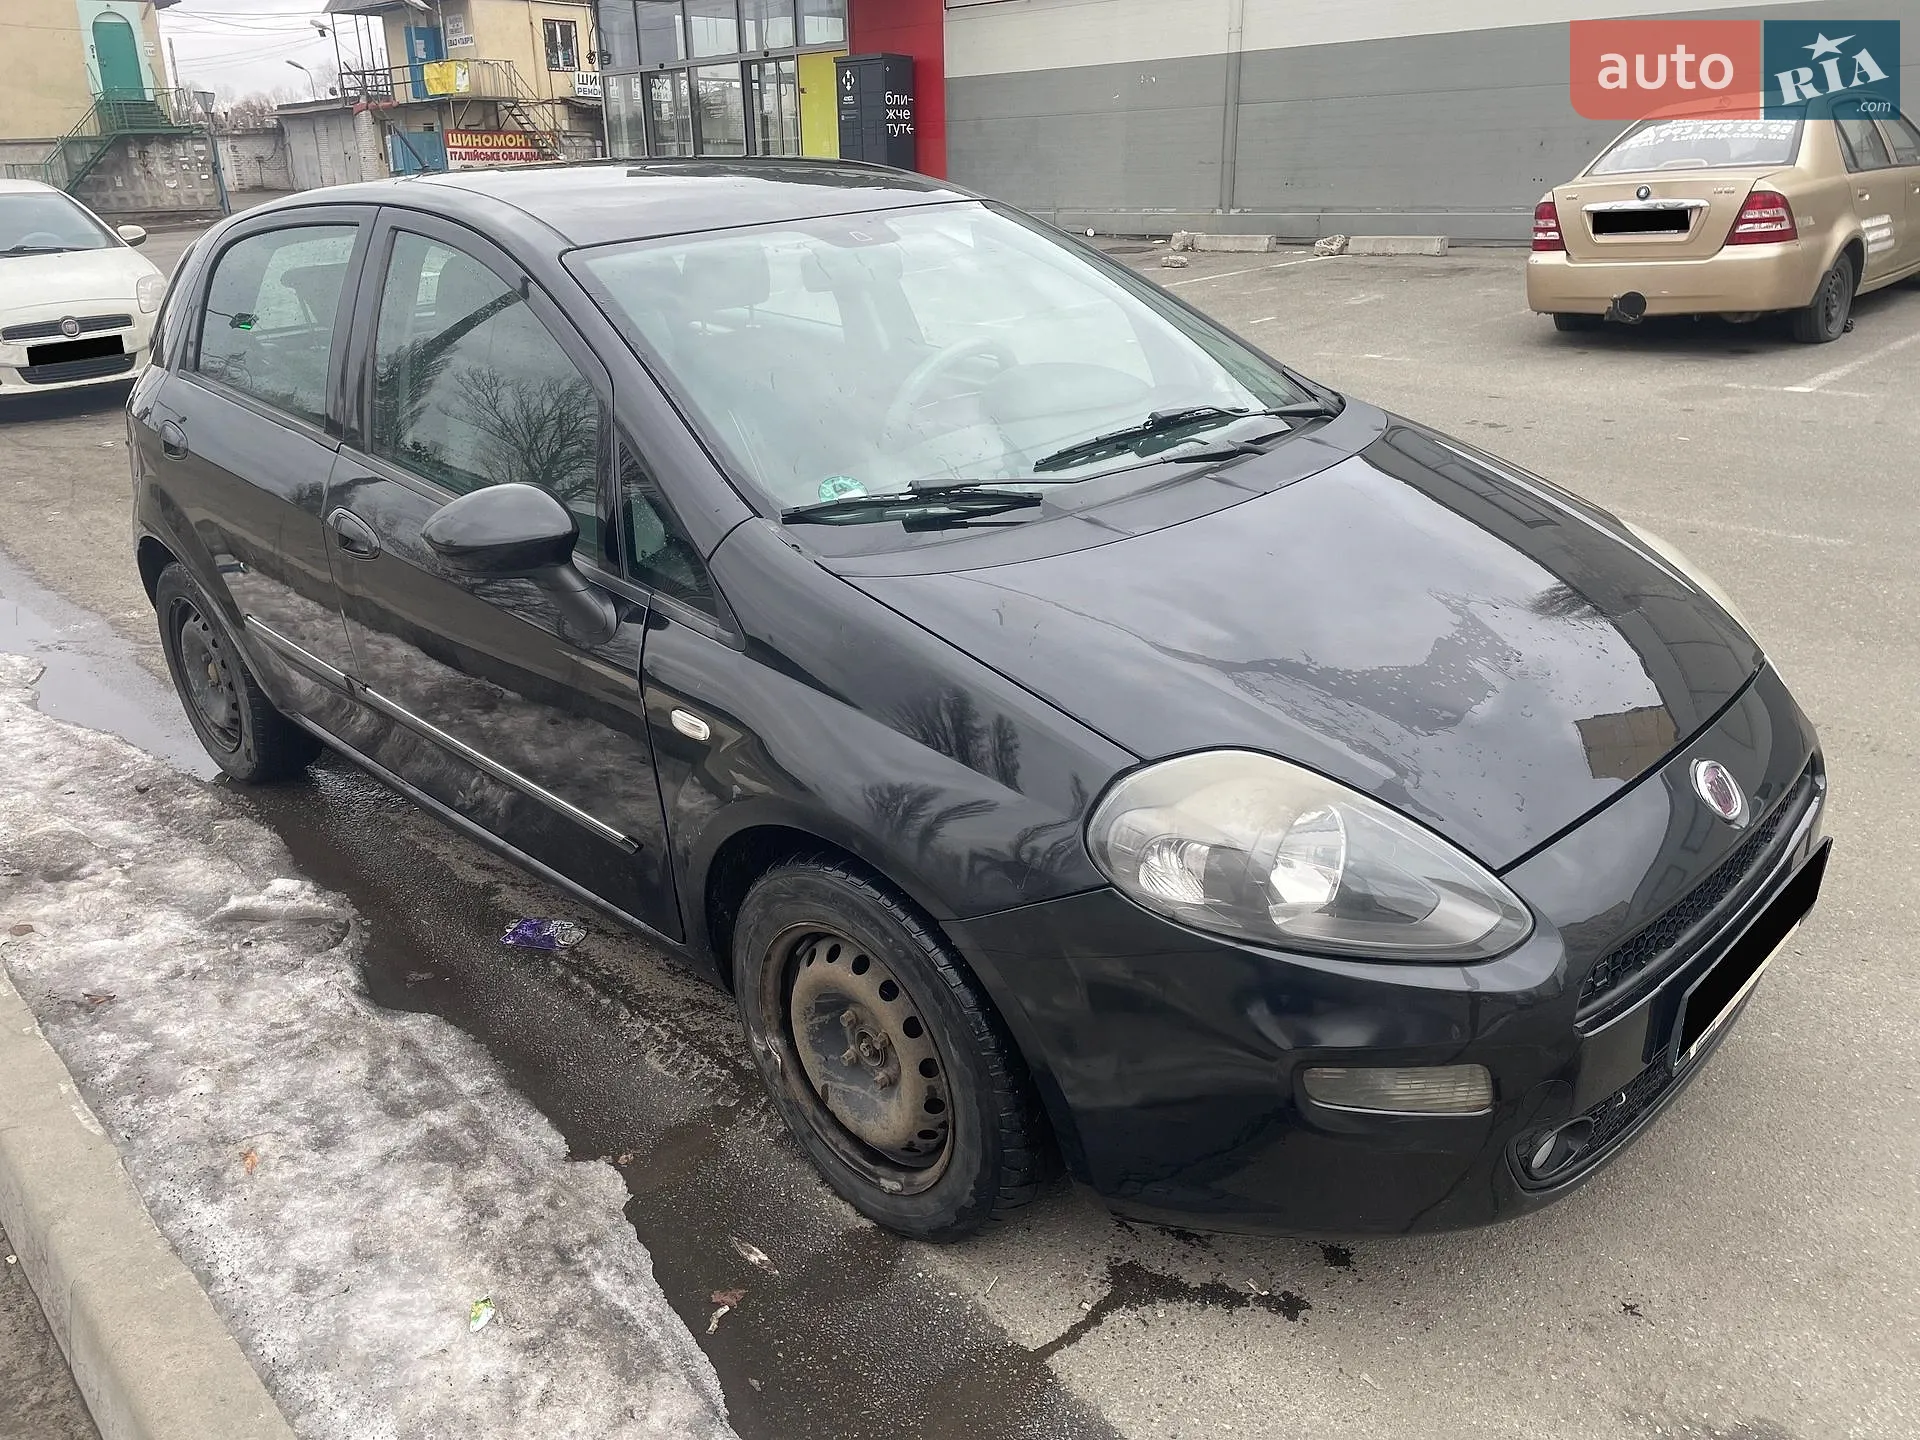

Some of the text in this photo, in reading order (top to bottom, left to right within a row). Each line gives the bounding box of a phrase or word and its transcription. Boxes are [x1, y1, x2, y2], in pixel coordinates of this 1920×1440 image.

[577, 73, 601, 86] ШИ
[885, 91, 914, 106] бли-
[885, 109, 911, 120] жче
[886, 123, 907, 137] тут
